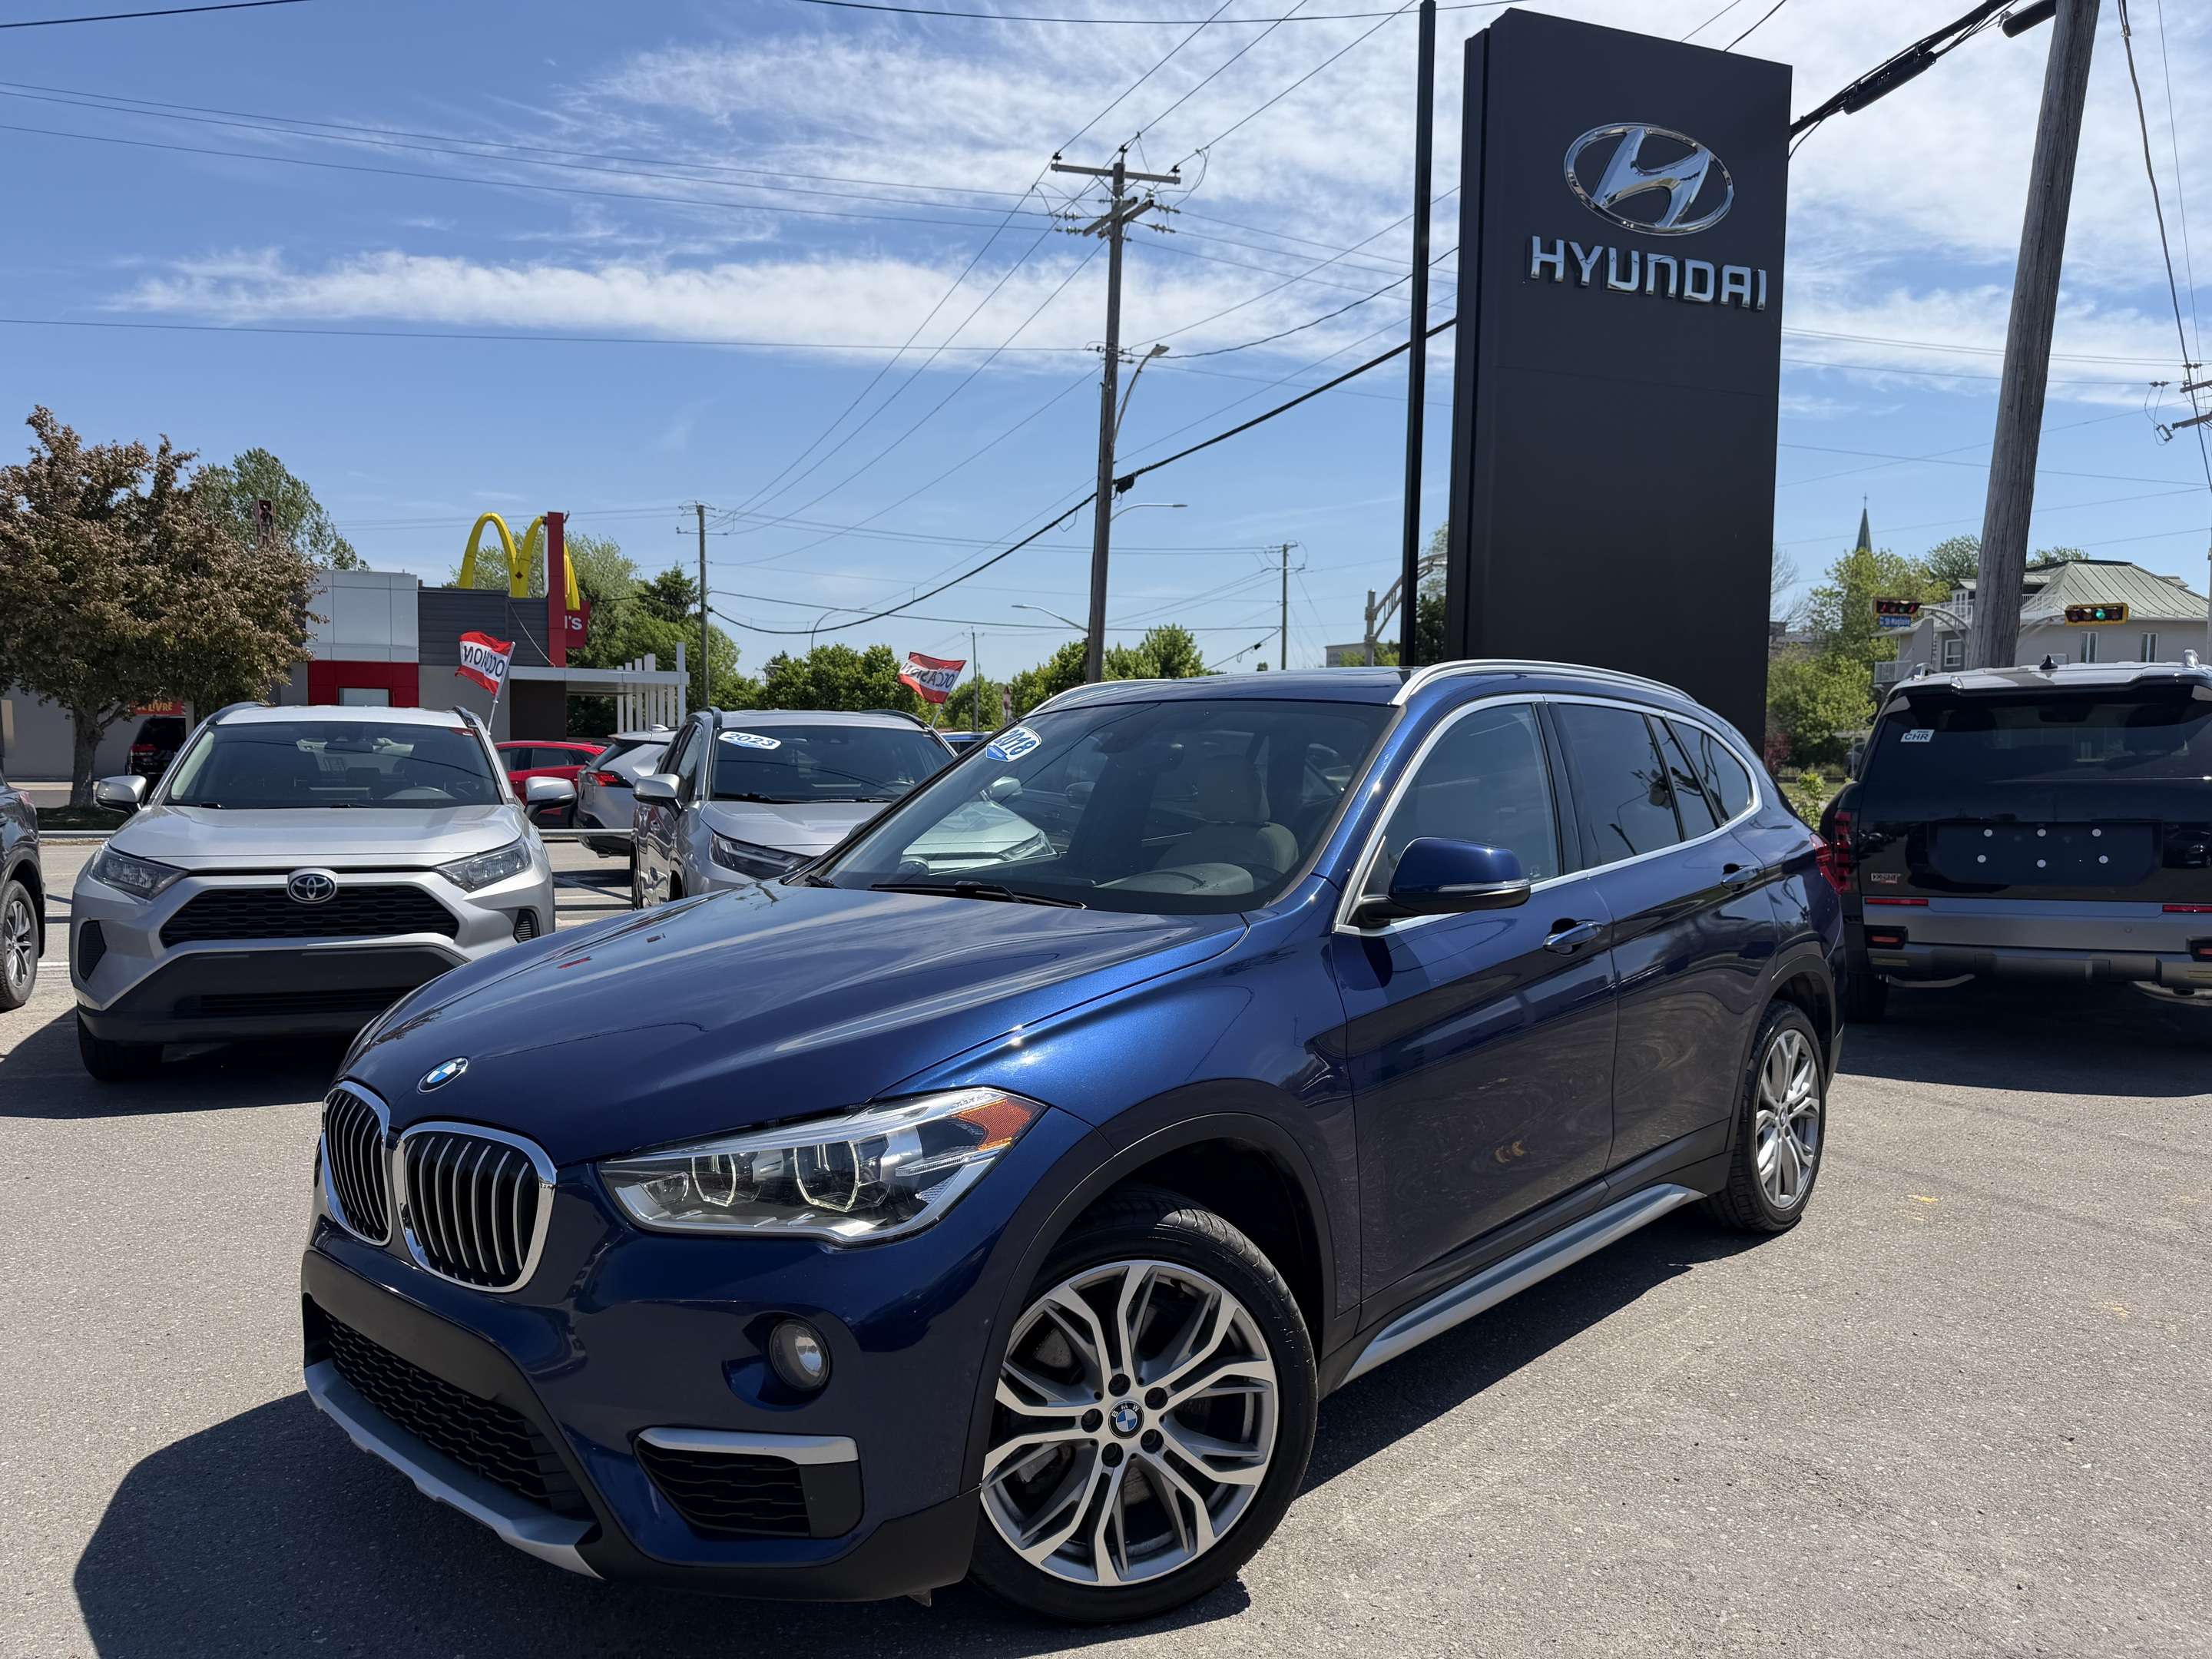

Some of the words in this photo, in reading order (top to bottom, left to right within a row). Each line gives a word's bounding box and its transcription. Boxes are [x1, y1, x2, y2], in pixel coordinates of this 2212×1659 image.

[1530, 235, 1767, 311] HYUNDAI
[724, 733, 776, 746] 2023
[994, 729, 1037, 756] 2018
[1111, 1403, 1141, 1418] BMW
